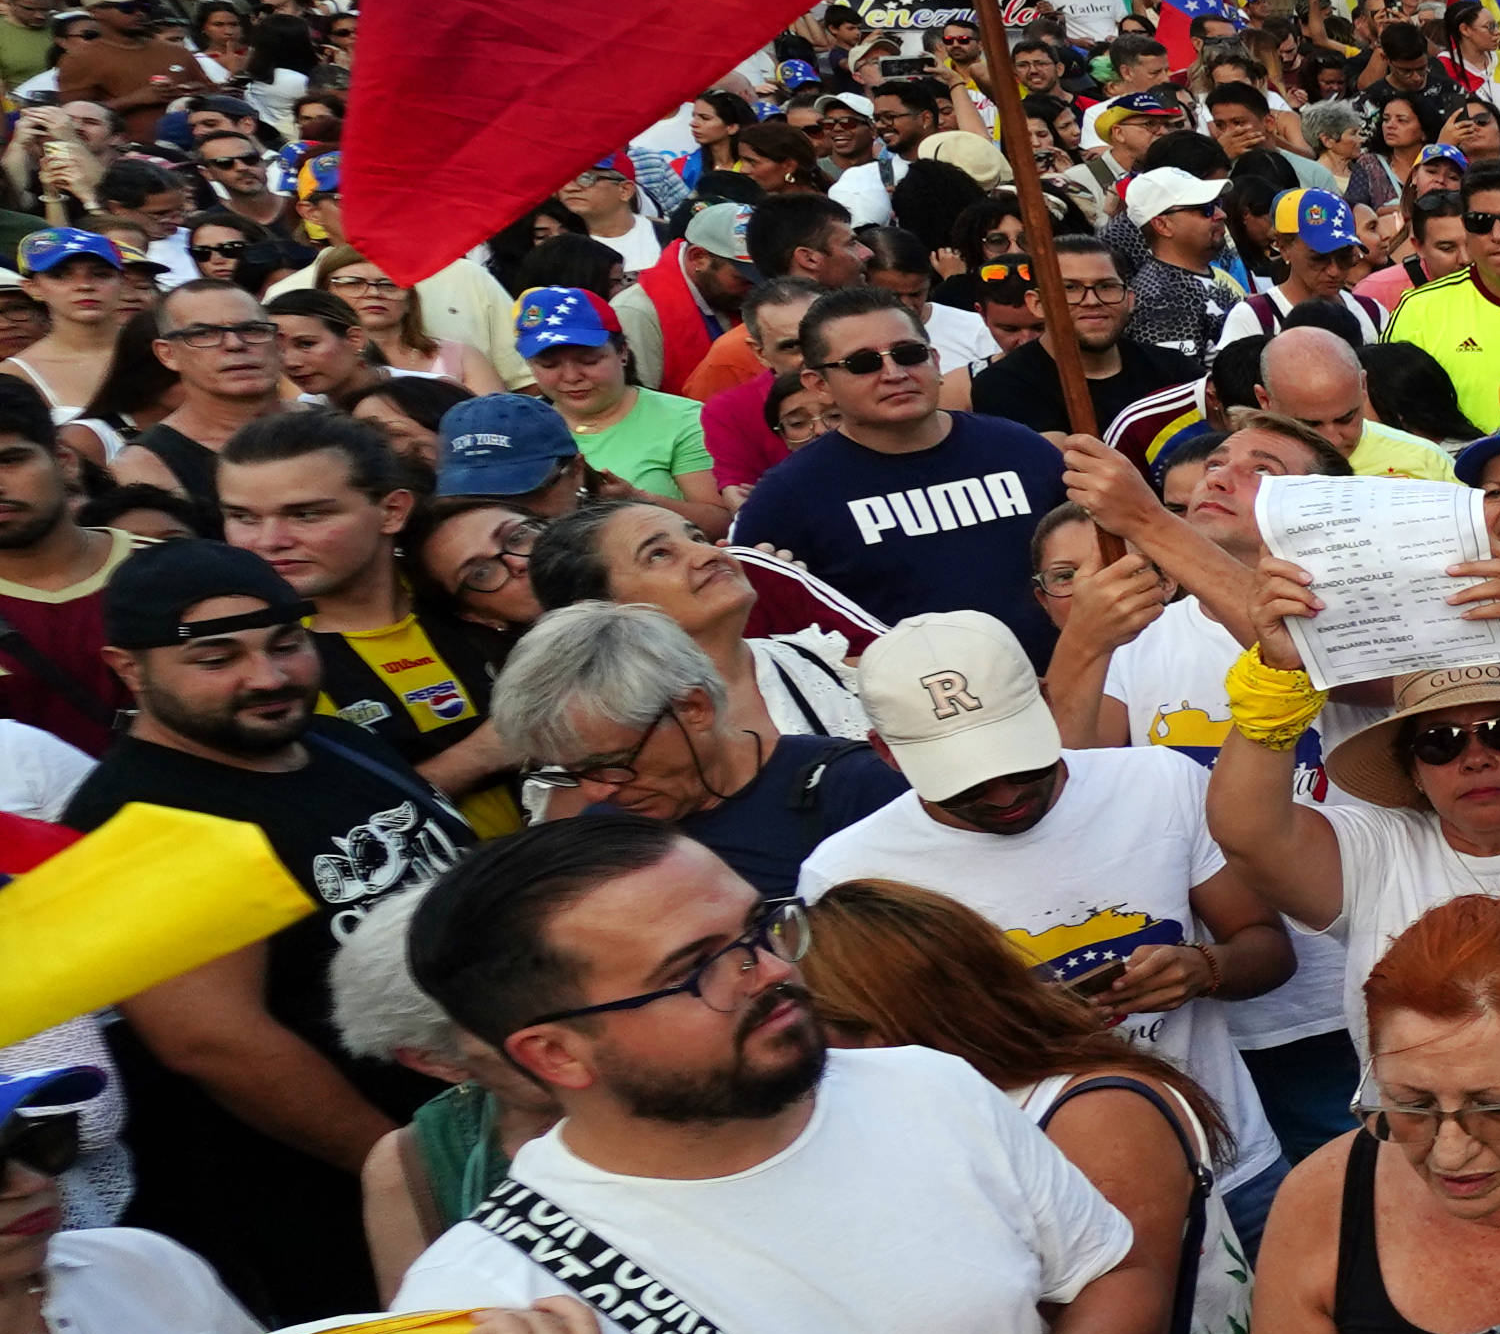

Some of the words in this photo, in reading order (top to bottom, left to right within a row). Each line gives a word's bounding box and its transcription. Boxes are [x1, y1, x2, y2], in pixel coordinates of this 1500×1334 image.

[1068, 2, 1112, 16] Father
[846, 470, 1033, 545] PUMA
[920, 670, 983, 721] R
